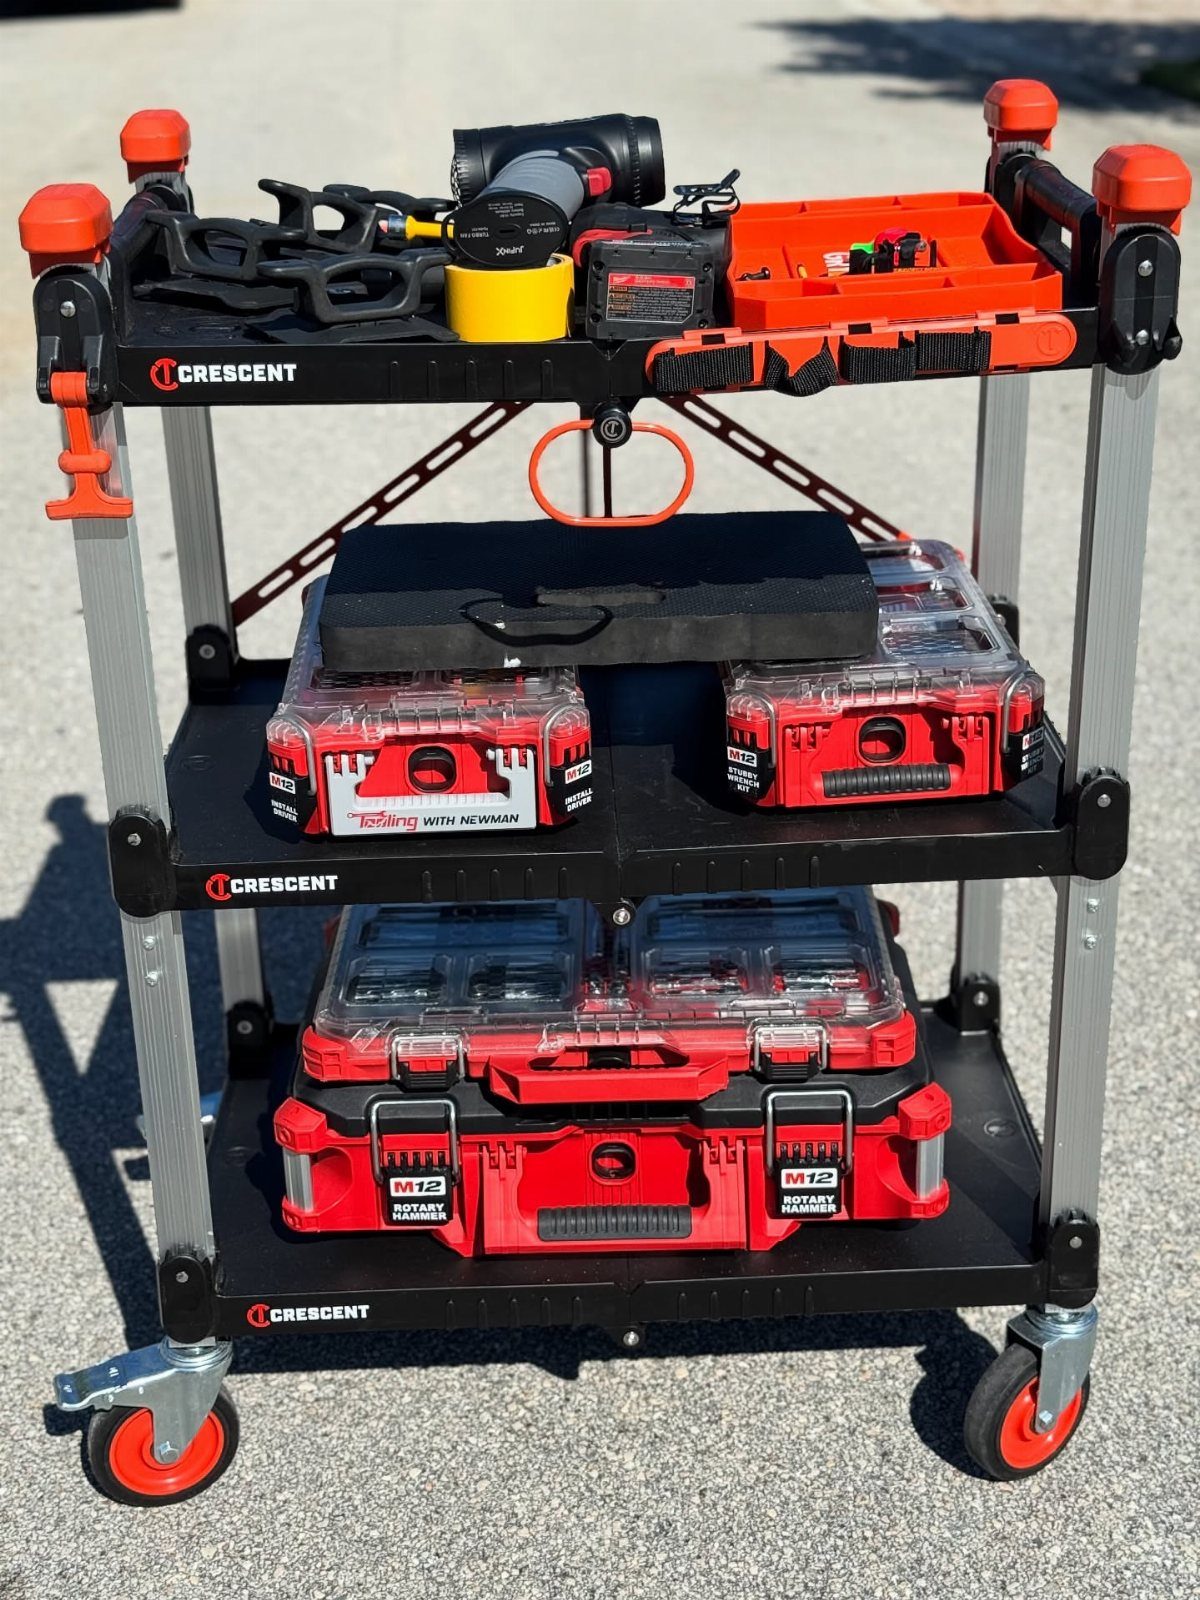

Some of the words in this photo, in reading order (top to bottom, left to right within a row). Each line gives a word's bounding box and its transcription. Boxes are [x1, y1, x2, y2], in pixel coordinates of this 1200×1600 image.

[178, 363, 297, 383] CRESCENT
[730, 750, 756, 765] M12
[567, 764, 590, 781] M12
[728, 766, 758, 780] STUBBY
[271, 775, 294, 790] M12
[727, 773, 760, 788] WRENCH
[737, 784, 750, 792] KIT
[565, 788, 593, 805] INSTALL
[567, 796, 592, 812] DRIVER
[271, 800, 299, 815] INSTALL
[273, 808, 298, 823] DRIVER
[423, 816, 455, 826] WITH
[460, 814, 519, 825] NEWMAN
[230, 875, 338, 894] CRESCENT
[785, 1172, 834, 1184] M12
[394, 1181, 442, 1193] M12
[783, 1195, 835, 1204] ROTARY
[393, 1203, 445, 1212] ROTARY
[781, 1204, 837, 1214] HAMMER
[392, 1212, 447, 1220] HAMMER
[270, 1304, 370, 1323] CRESCENT
